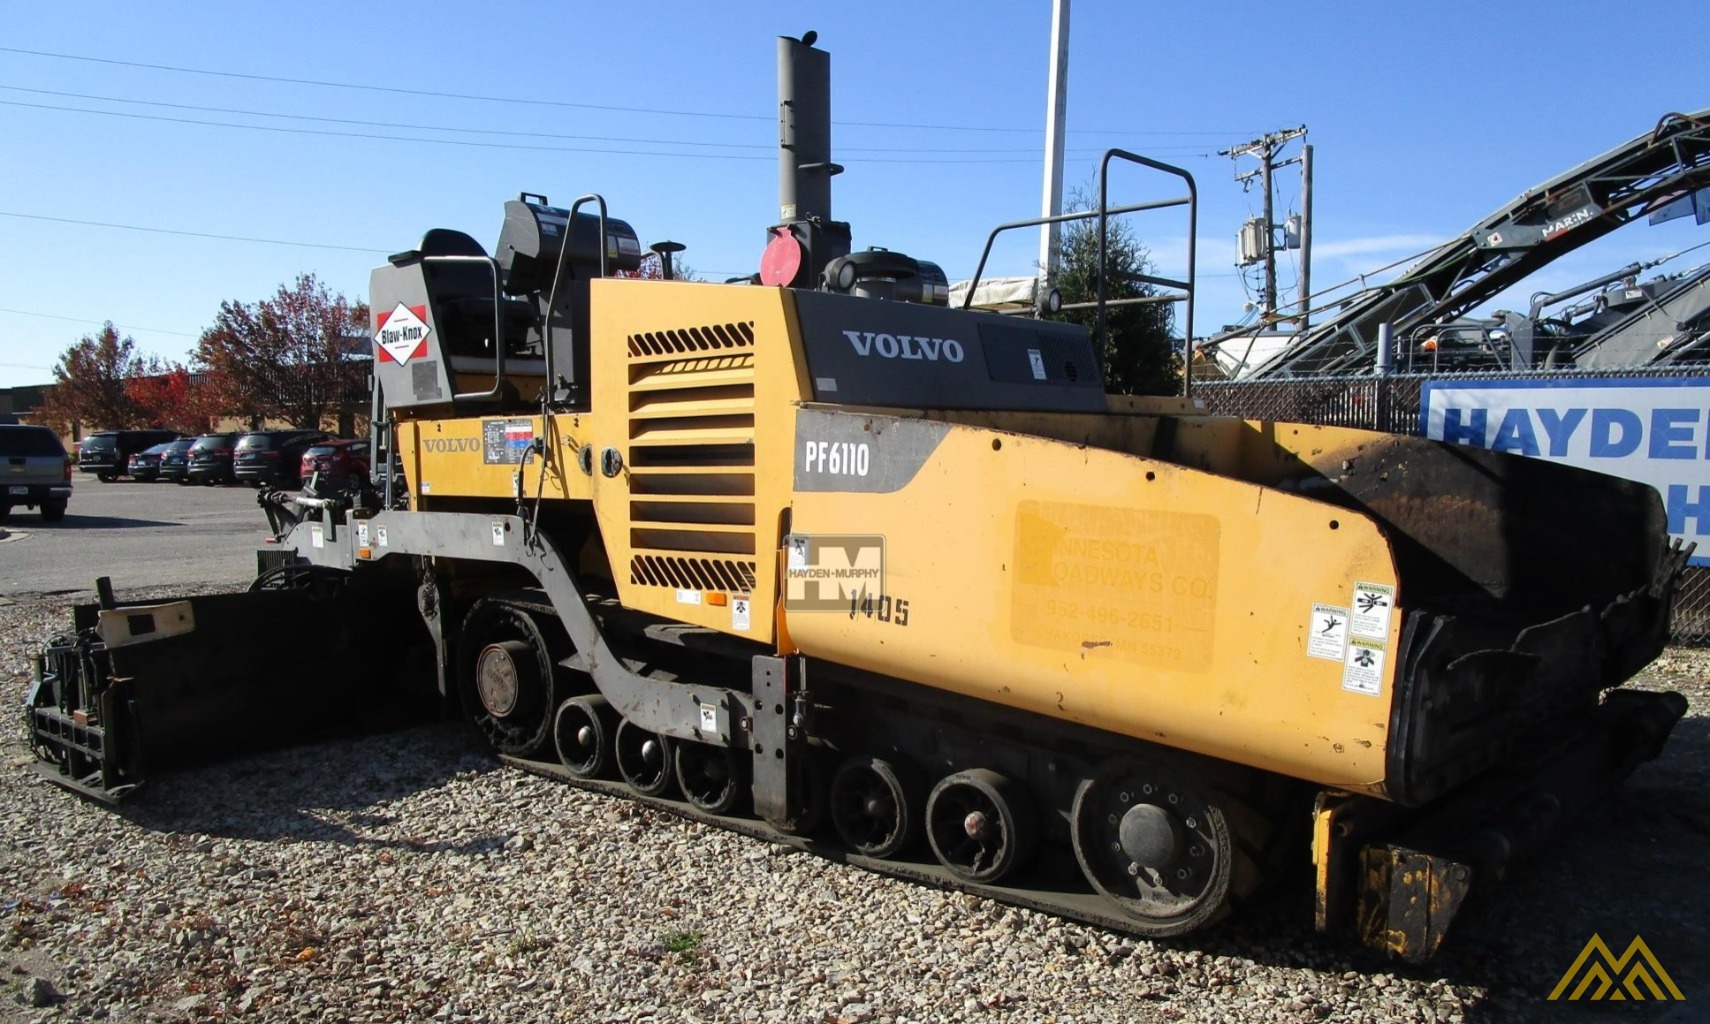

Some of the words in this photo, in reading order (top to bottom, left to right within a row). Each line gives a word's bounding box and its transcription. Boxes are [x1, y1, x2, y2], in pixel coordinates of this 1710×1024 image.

[381, 326, 422, 345] Blaw-Knox
[843, 330, 964, 363] VOLVO
[423, 438, 481, 453] VOLVO
[1443, 408, 1710, 460] HAYDE
[805, 441, 870, 477] PF6110
